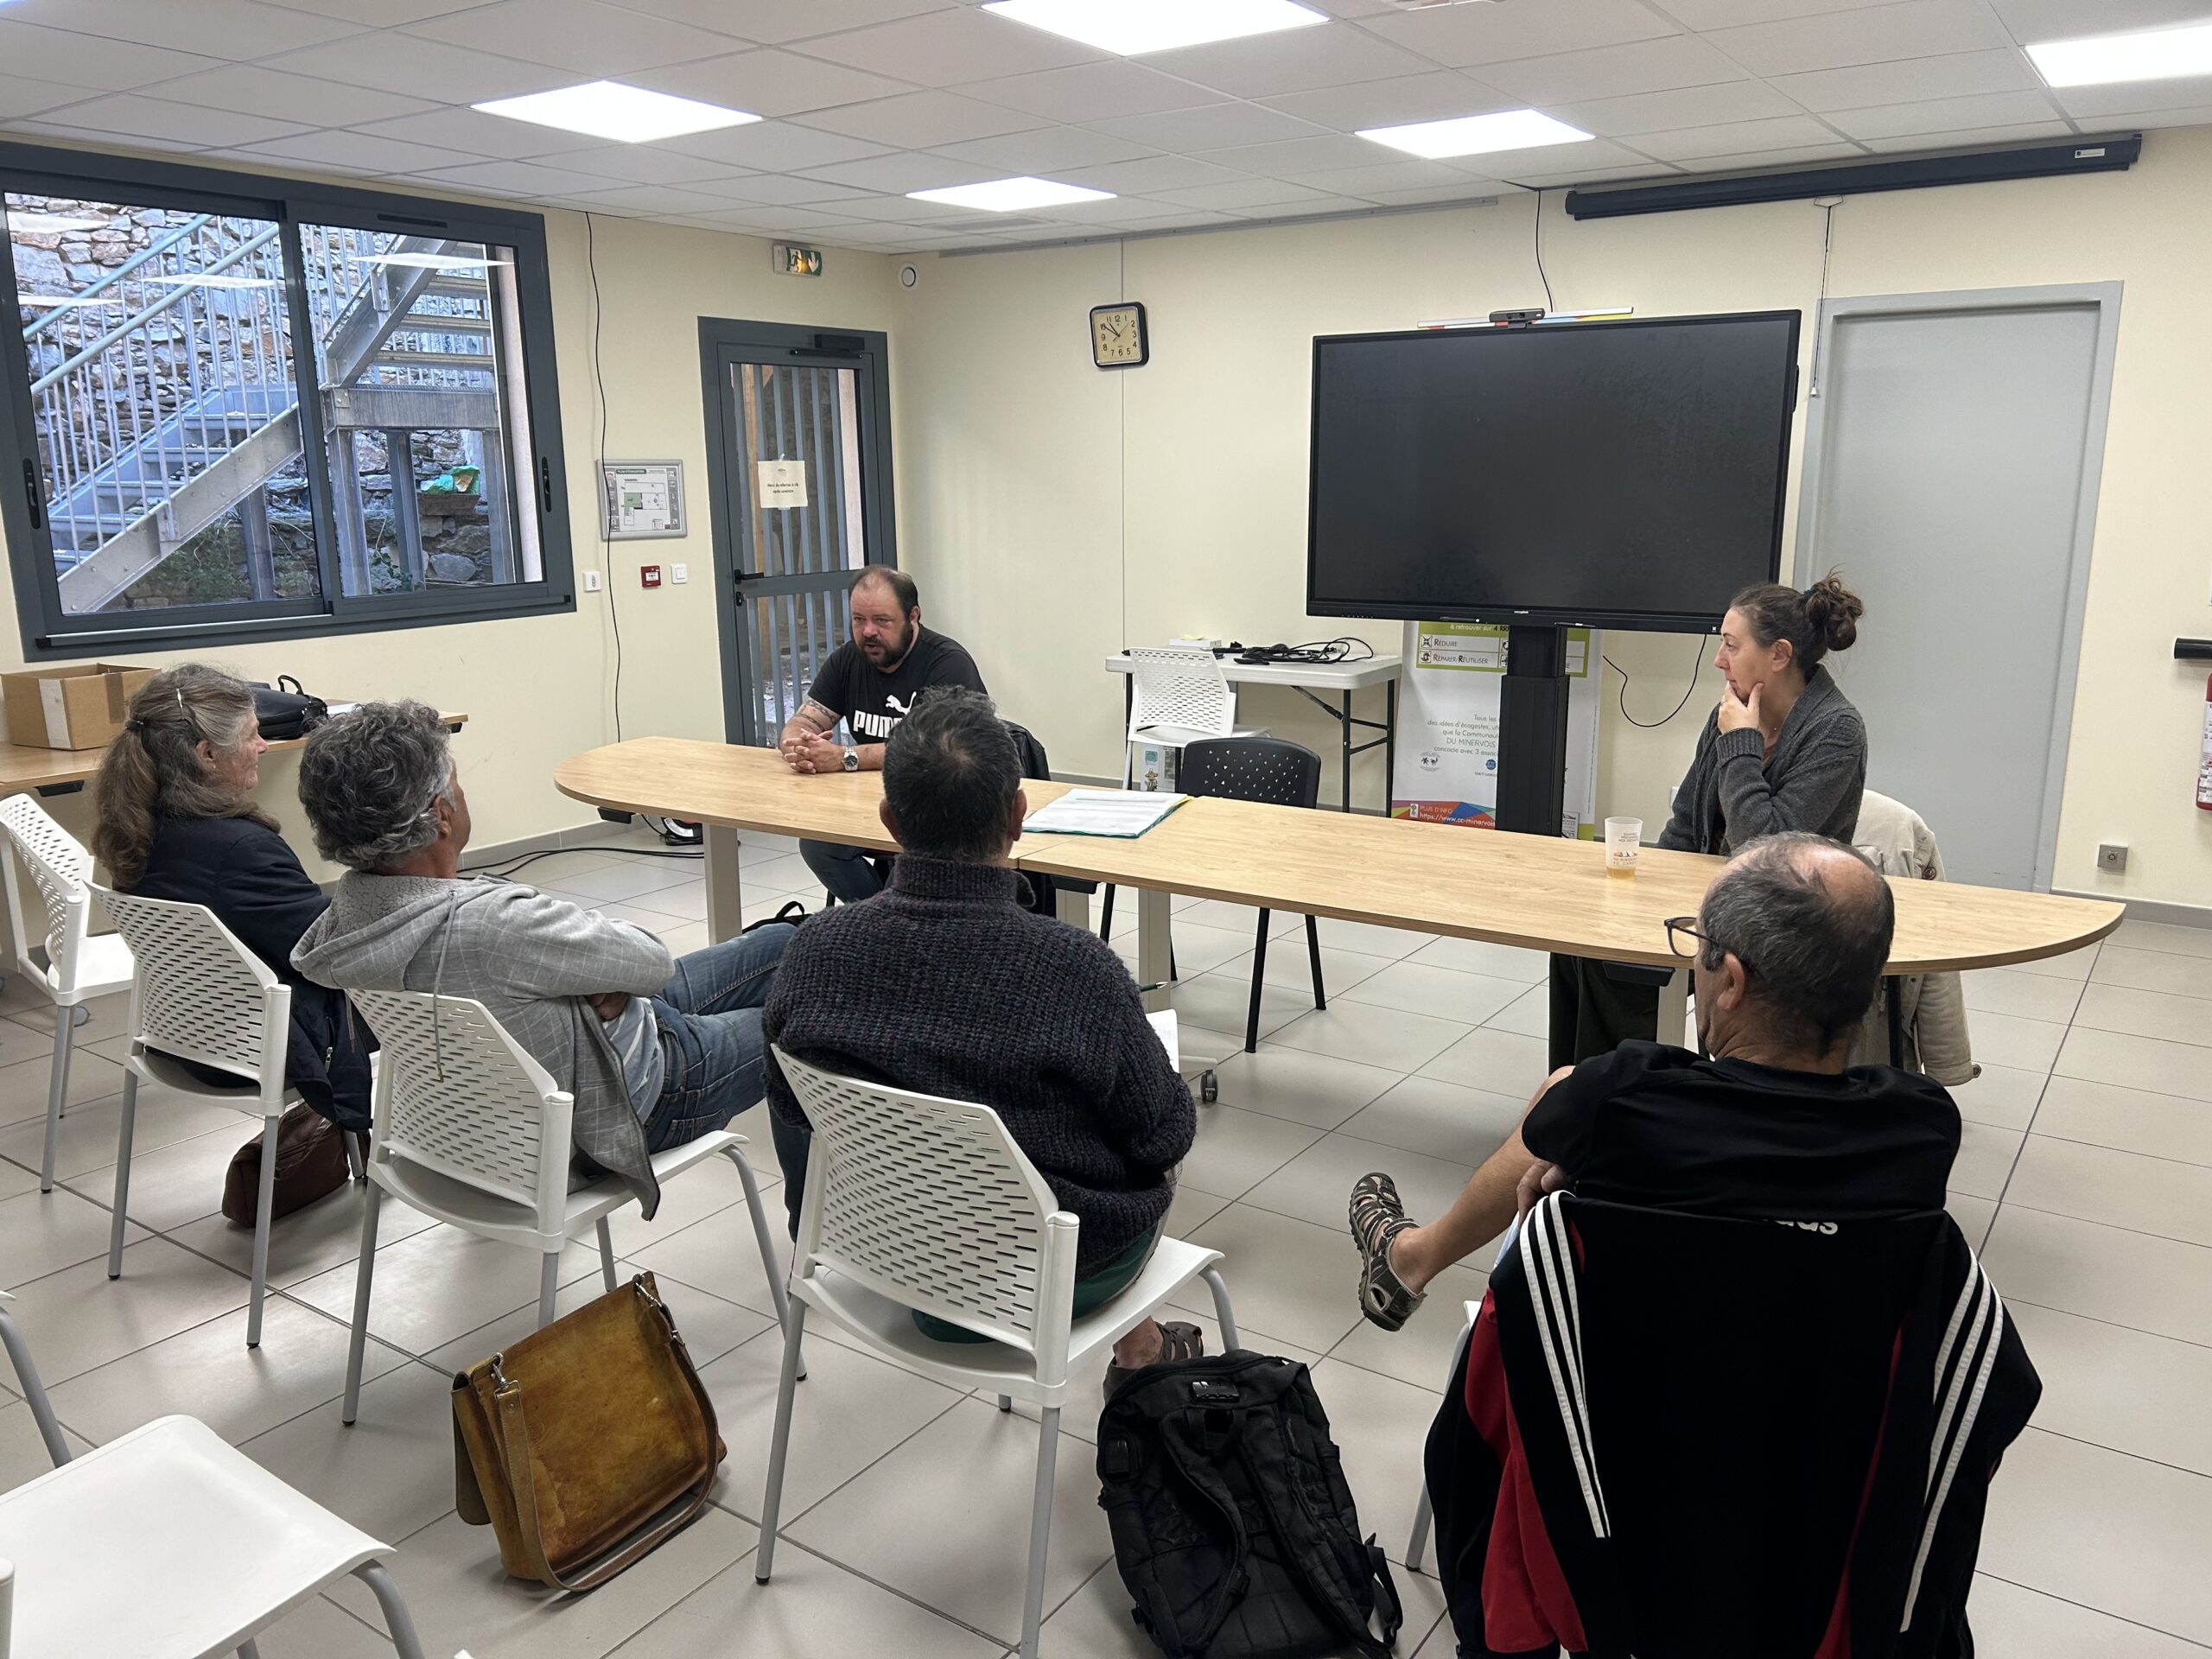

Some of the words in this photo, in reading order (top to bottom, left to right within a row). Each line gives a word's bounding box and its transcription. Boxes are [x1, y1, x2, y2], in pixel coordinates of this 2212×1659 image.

[1474, 714, 1487, 722] Tous
[853, 709, 903, 739] PUM
[1439, 719, 1454, 728] idées
[1455, 721, 1491, 730] d'écogestes,
[1419, 804, 1433, 813] PLUS
[1434, 806, 1453, 815] D'INFO
